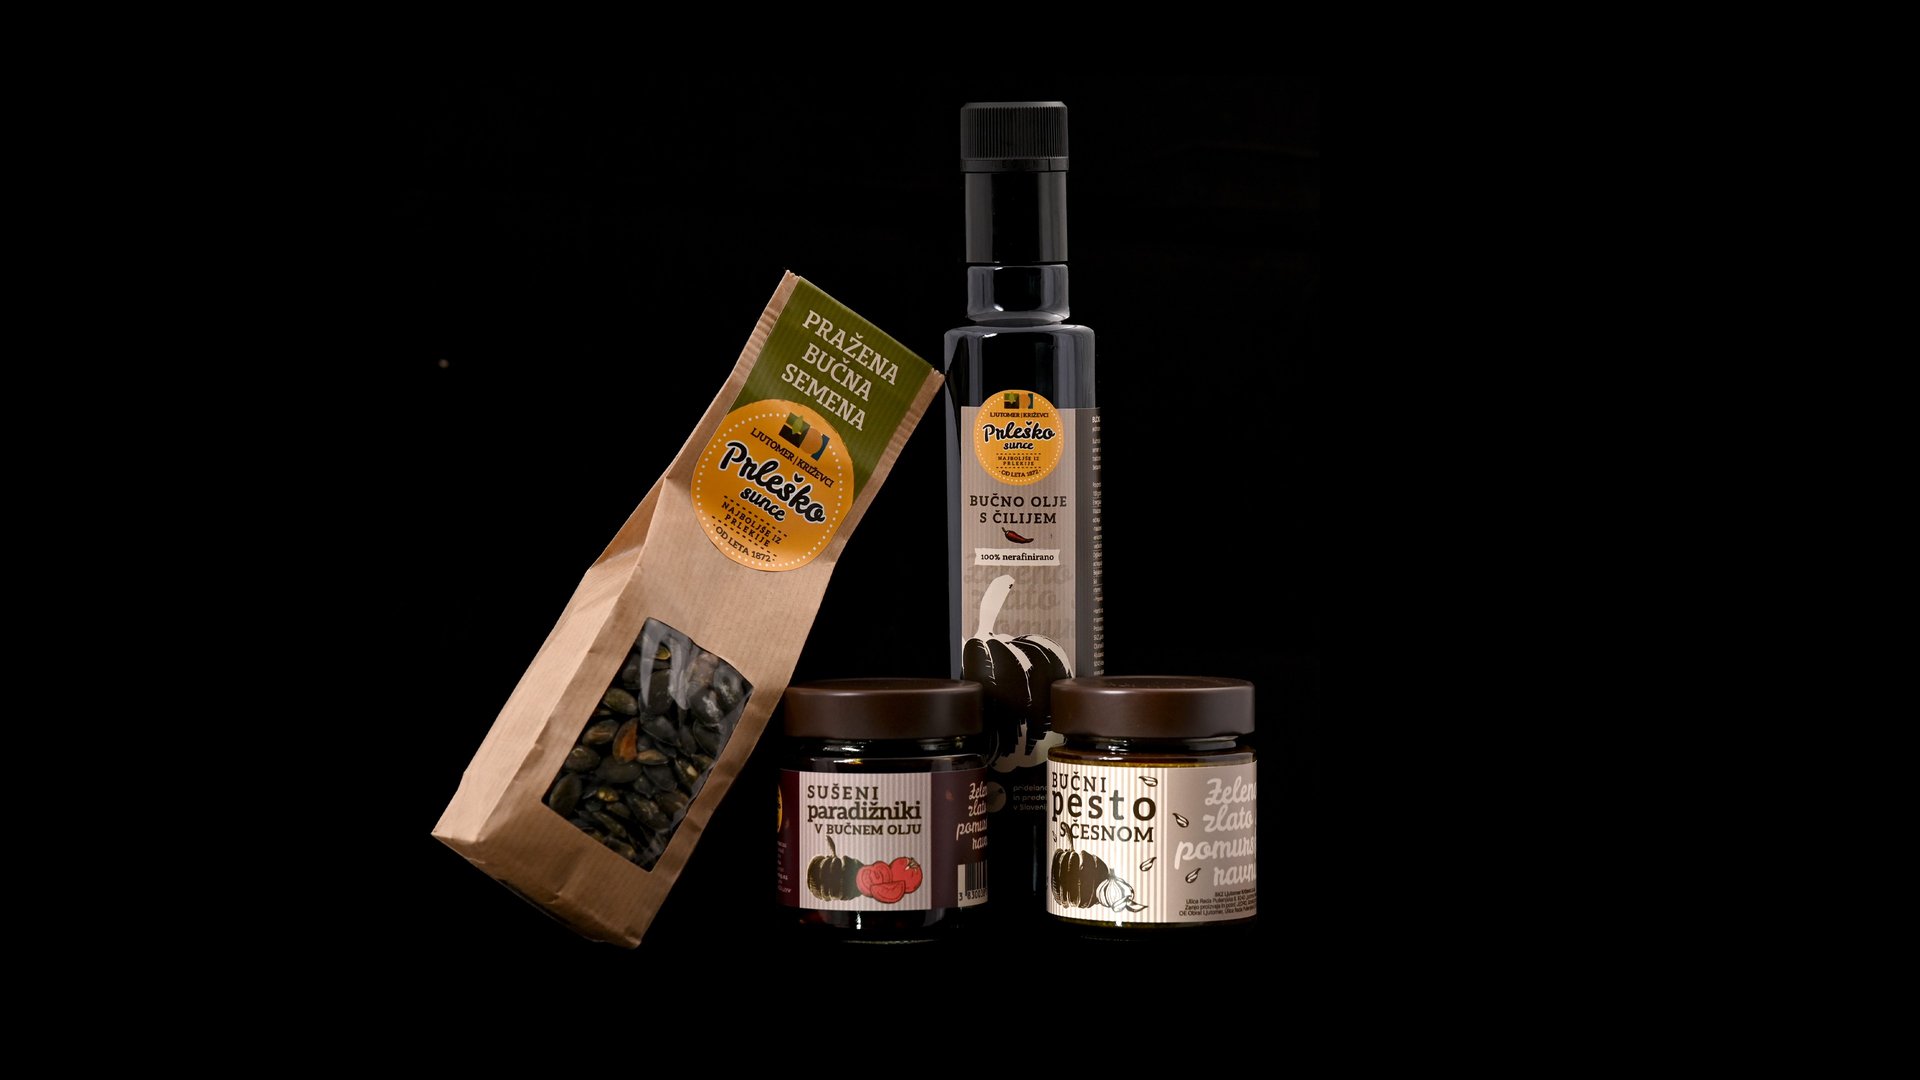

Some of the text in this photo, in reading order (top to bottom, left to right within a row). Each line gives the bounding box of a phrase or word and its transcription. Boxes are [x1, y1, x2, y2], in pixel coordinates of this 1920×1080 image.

[802, 309, 899, 386] PRAŽENA
[801, 342, 873, 402] BUČNA
[781, 363, 867, 431] SEMENA
[982, 421, 1056, 443] Prleško
[750, 428, 835, 488] LJUTOMER KRIŽEVCI
[1003, 442, 1034, 451] sunce
[719, 441, 826, 524] Prleško
[739, 486, 787, 522] sunce
[970, 493, 1067, 507] BUČNO OLJE
[721, 501, 782, 545] NAJBOLJŠE IZ
[980, 510, 1057, 524] S ČILIJEM
[724, 513, 771, 548] PRLEKIJE
[715, 526, 771, 562] OD LETA 1872
[981, 552, 1054, 561] 100% nerafinirano
[807, 783, 879, 801] SUŠENI
[1052, 771, 1106, 793] BUČNI
[807, 801, 922, 822] paradižniki
[1052, 790, 1156, 823] pesto
[1202, 804, 1254, 833] zlato
[815, 823, 922, 835] V BUČNEM OLJU
[1070, 819, 1154, 843] ČESNOM
[959, 892, 963, 901] 3
